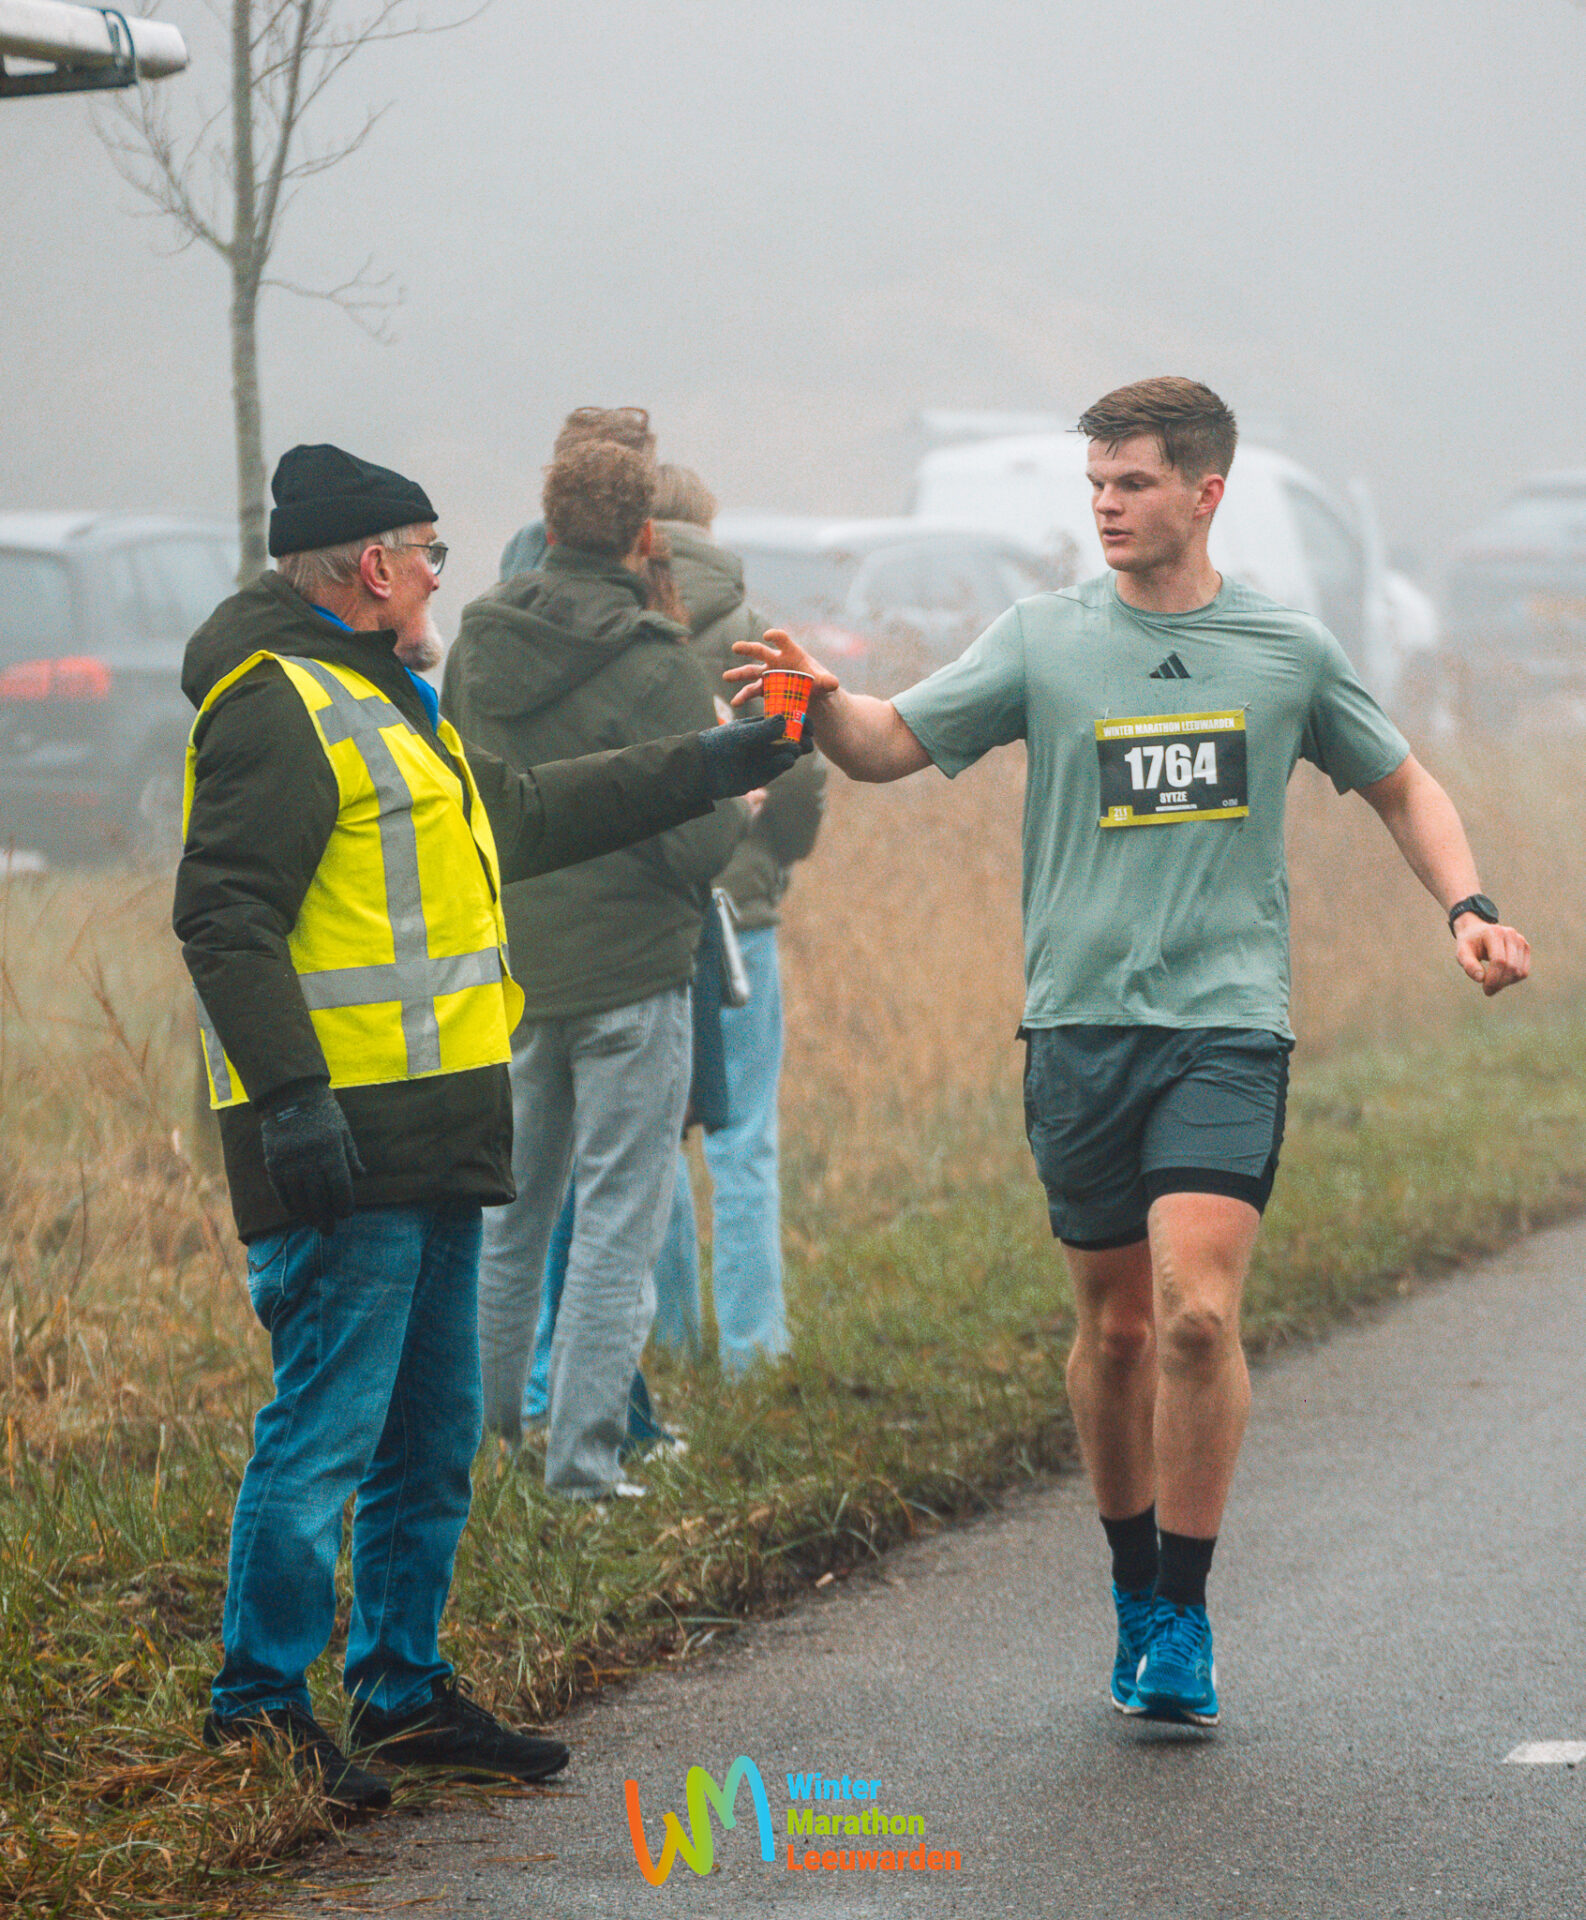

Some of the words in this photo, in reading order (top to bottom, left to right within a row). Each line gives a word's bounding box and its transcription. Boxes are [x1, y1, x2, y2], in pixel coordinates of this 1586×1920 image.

[1103, 725, 1134, 737] WINTER
[1135, 721, 1180, 735] MARATHON
[1181, 717, 1235, 732] LEEUWARDEN
[1124, 741, 1218, 790] 1764
[1159, 791, 1188, 804] SYTZE
